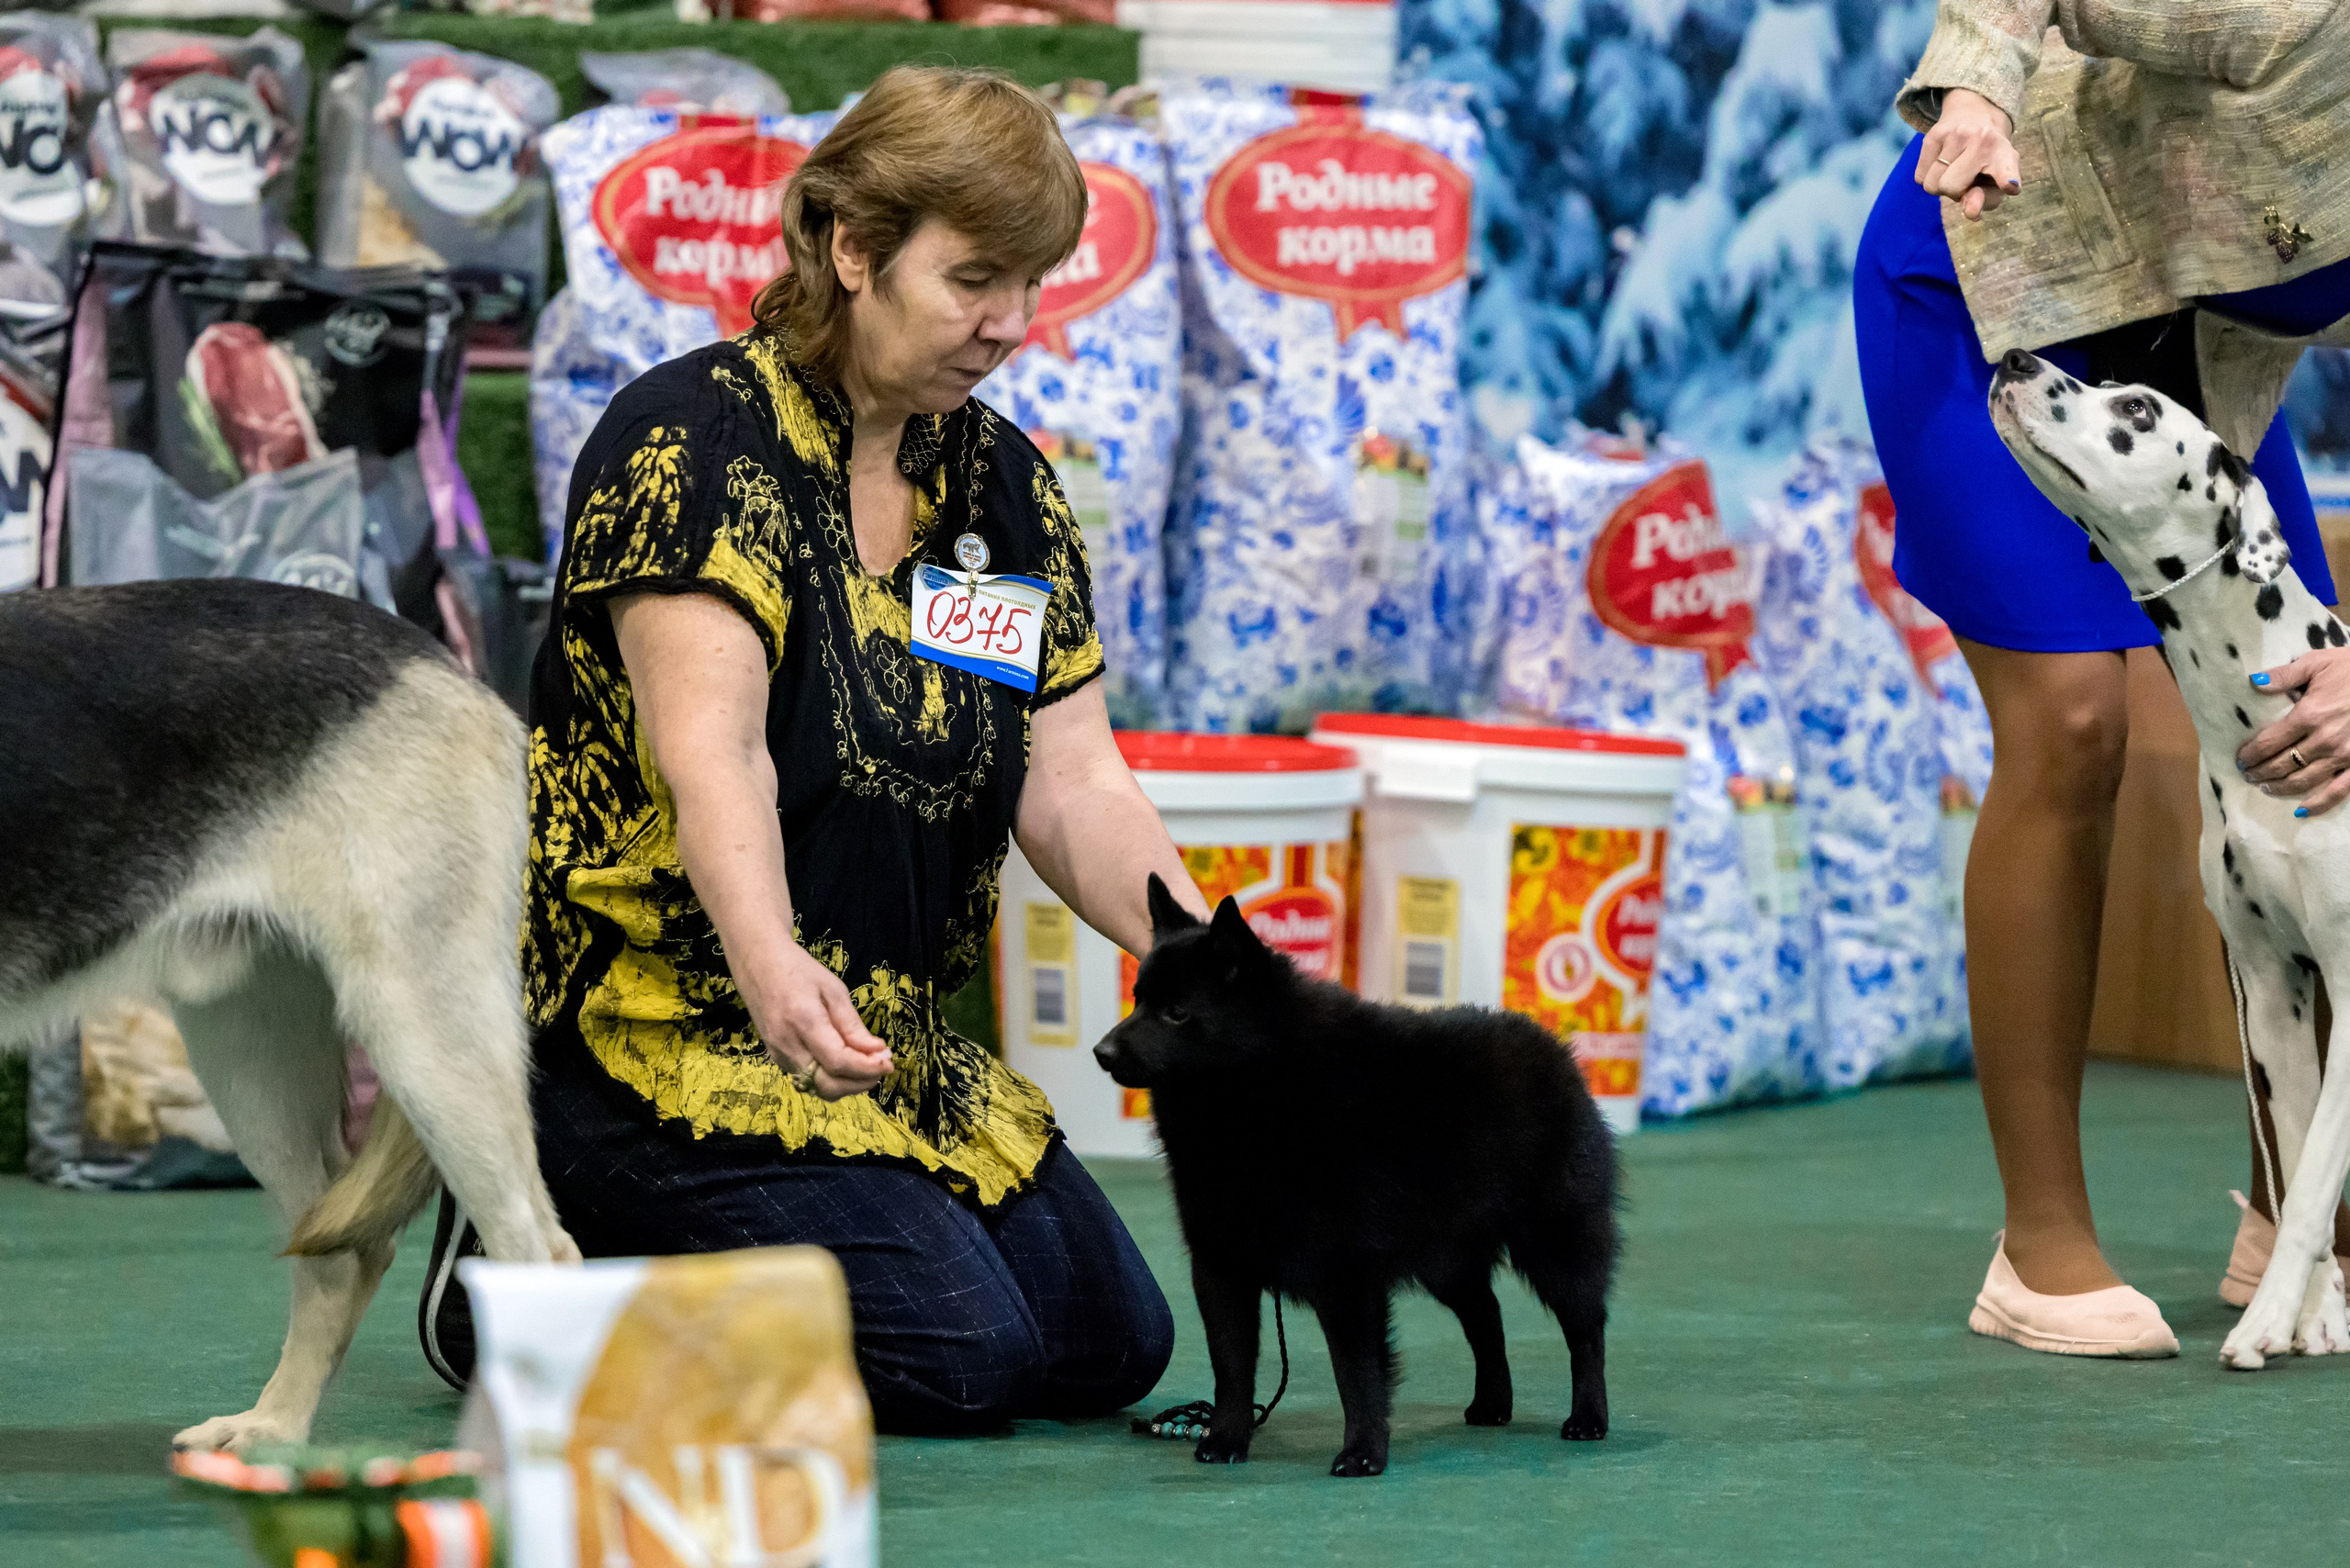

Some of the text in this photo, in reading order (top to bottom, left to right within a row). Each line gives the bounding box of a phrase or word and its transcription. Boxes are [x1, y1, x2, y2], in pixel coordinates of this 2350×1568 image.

[1255, 158, 1438, 212] Родные
[1276, 225, 1436, 275] корма
[922, 569, 949, 585] Farmina
[927, 590, 1032, 655] 0375
